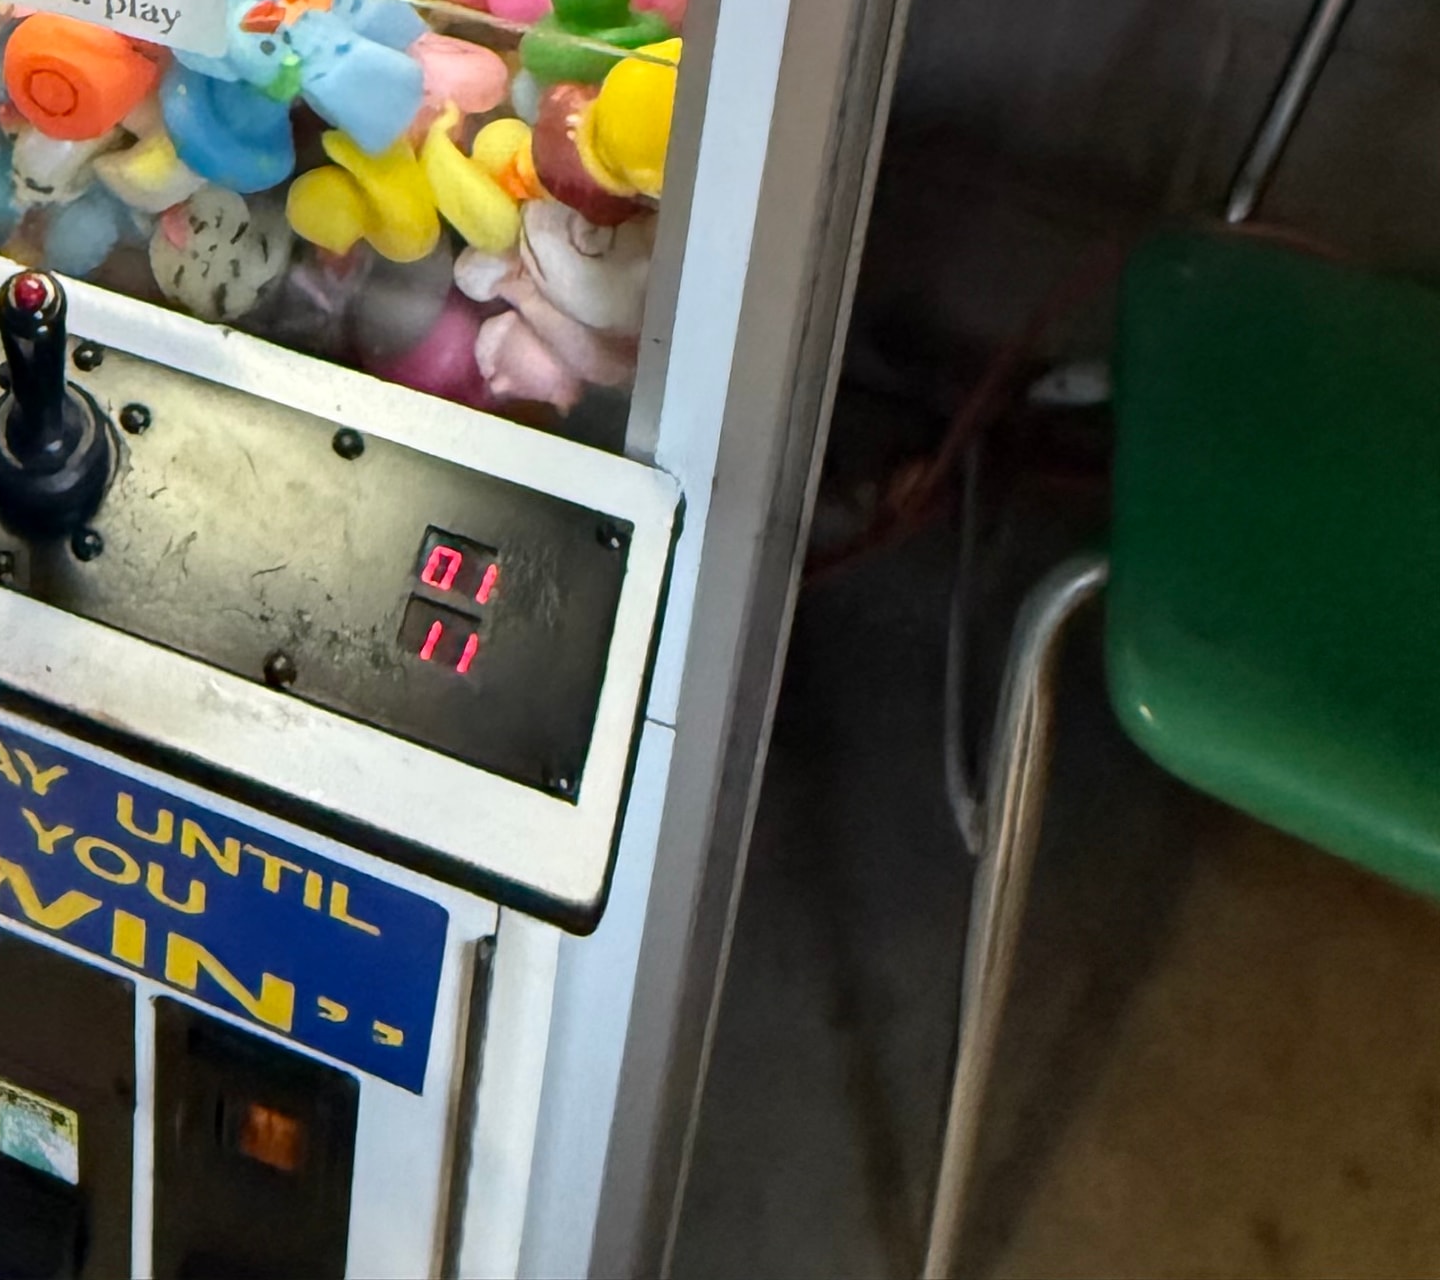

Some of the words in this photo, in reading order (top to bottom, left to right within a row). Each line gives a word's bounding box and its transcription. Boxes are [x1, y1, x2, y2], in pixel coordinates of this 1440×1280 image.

[420, 544, 500, 606] 01
[20, 806, 208, 915] YOU
[115, 791, 382, 937] UNTIL
